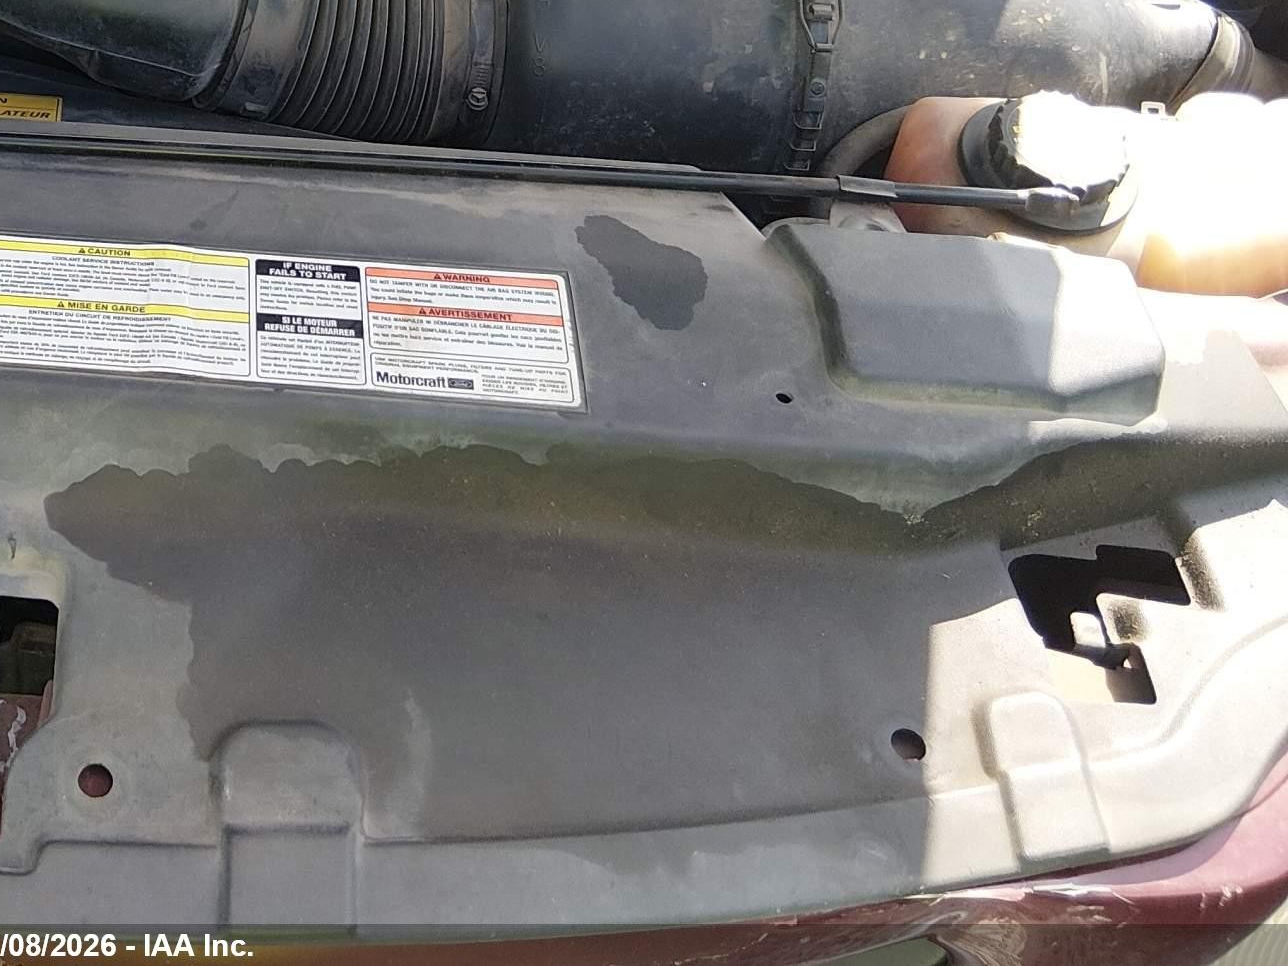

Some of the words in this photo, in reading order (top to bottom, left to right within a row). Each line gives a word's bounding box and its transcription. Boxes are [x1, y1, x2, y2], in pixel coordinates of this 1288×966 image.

[87, 248, 131, 256] CAUTION
[52, 255, 81, 263] COOLANT
[295, 263, 332, 272] ENGINE
[269, 268, 297, 276] FAILS
[299, 270, 313, 278] TO
[315, 271, 347, 280] START
[443, 273, 491, 283] WARNING
[67, 301, 92, 309] MISE
[95, 302, 109, 310] EN
[111, 305, 146, 313] GARDE
[428, 309, 513, 321] AVERTISSEMENT
[281, 316, 290, 324] SI
[292, 317, 302, 325] LE
[304, 318, 338, 327] MOTEUR
[264, 323, 295, 332] REFUSE
[297, 325, 308, 333] DE
[310, 325, 355, 336] DÉMARRER
[375, 371, 446, 388] Motorcraft
